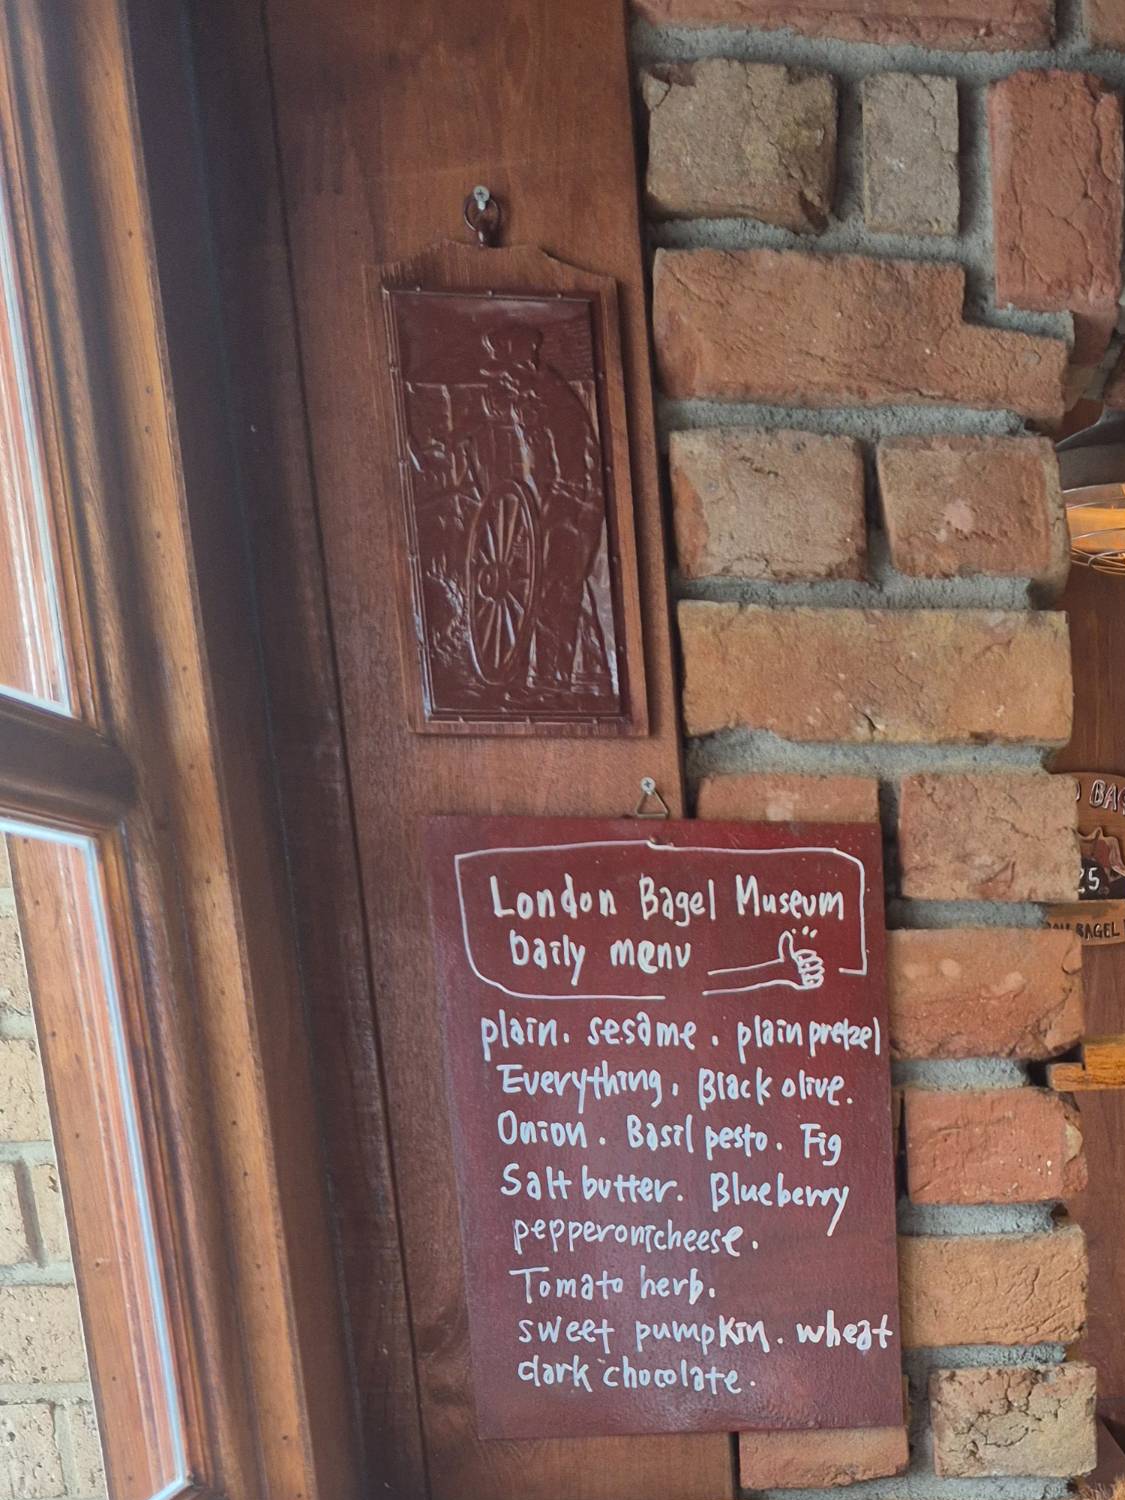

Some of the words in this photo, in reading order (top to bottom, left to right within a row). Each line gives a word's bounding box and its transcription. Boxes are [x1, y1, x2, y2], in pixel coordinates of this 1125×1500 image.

[489, 872, 617, 921] London
[638, 872, 717, 927] Bagel
[735, 873, 845, 921] Museum
[509, 928, 587, 986] Daily
[609, 939, 692, 974] menu
[699, 1066, 774, 1112] Black
[626, 1113, 694, 1154] Basil
[799, 1123, 843, 1167] Fig
[500, 1162, 573, 1201] Salt
[710, 1170, 850, 1238] Blueberry
[509, 1266, 624, 1305] Tomato
[517, 1315, 616, 1355] sweet
[796, 1309, 894, 1349] wheat
[517, 1354, 594, 1393] dark
